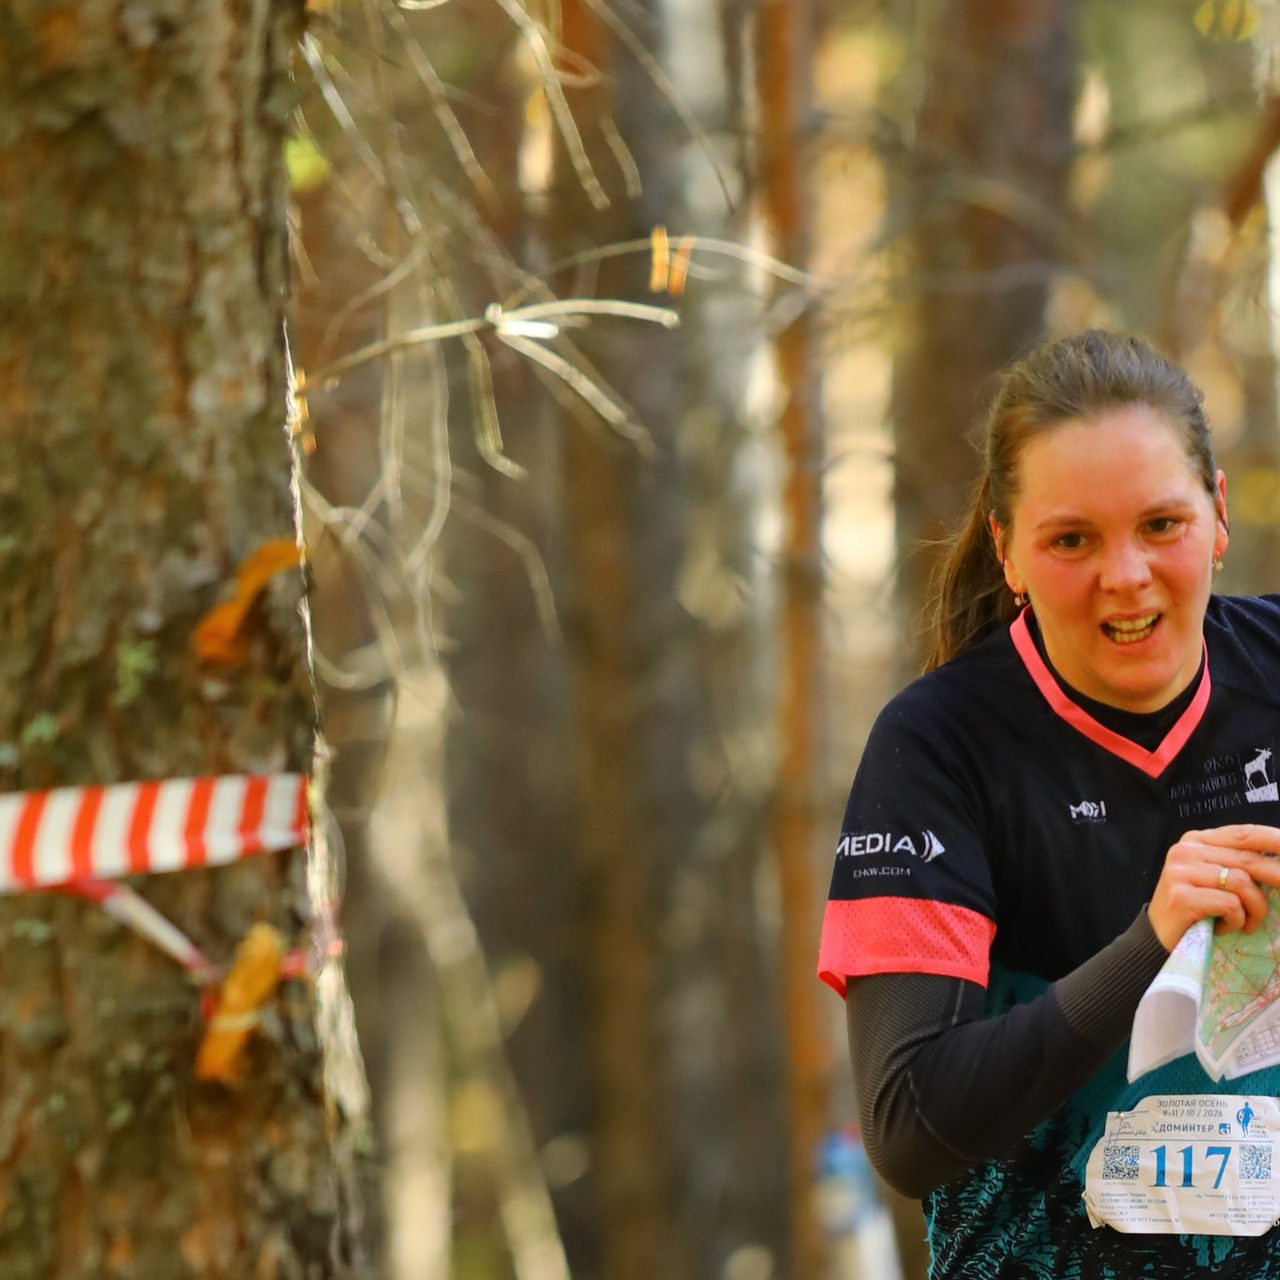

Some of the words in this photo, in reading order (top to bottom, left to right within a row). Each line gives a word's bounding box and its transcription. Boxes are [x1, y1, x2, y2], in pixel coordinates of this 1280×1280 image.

[1157, 1100, 1197, 1108] ЗОЛОТАЯ
[1199, 1099, 1228, 1108] ОСЕНЬ
[1150, 1144, 1232, 1189] 117
